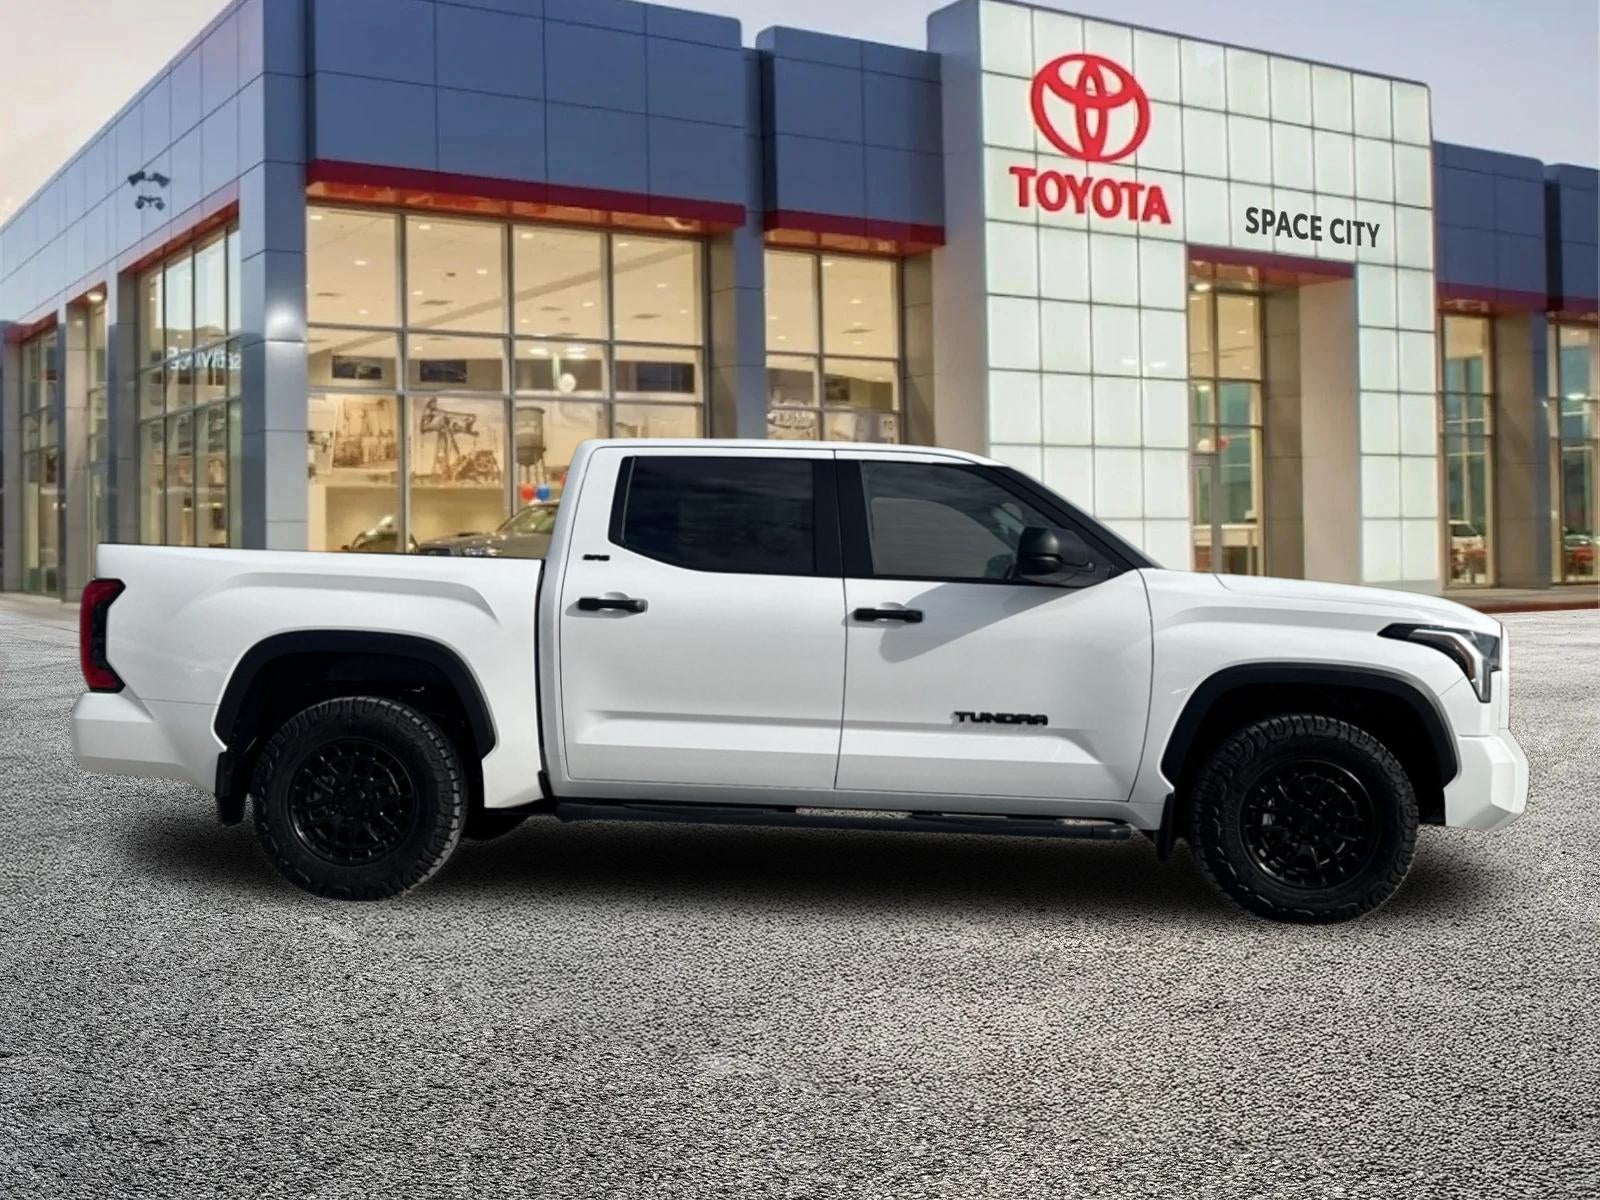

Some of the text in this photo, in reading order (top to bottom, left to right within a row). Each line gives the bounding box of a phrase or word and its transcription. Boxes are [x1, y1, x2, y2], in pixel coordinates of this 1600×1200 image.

[1009, 166, 1171, 225] TOYOTA
[1245, 206, 1381, 248] SPACE CITY
[953, 711, 1049, 726] TUNDRA
